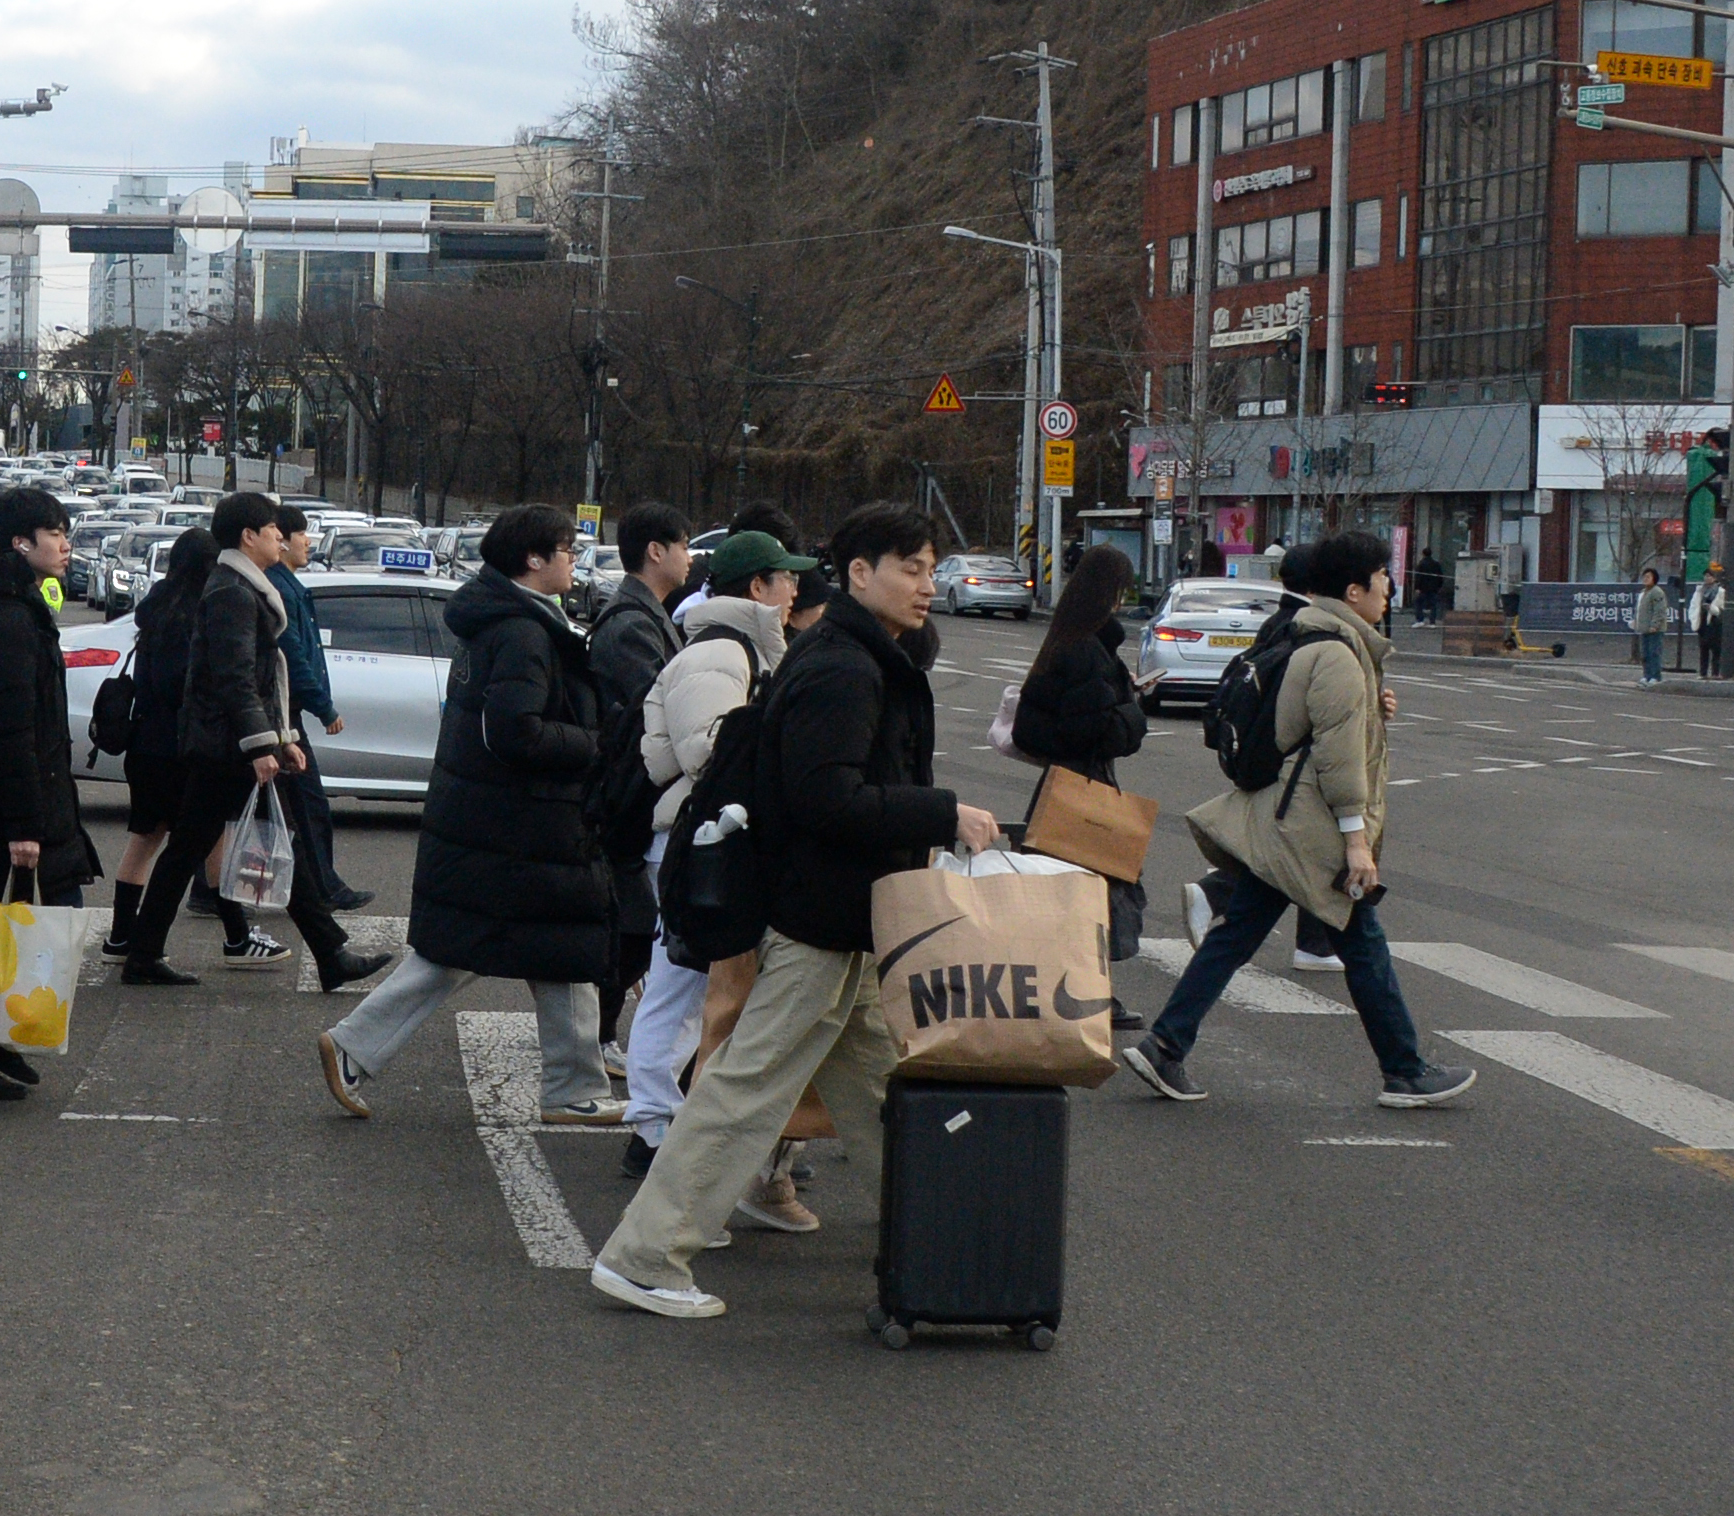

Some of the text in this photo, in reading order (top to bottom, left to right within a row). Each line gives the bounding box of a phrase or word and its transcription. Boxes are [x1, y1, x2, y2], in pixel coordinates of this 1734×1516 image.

[1607, 57, 1703, 83] 신호 과속 단속 장비
[1048, 410, 1069, 430] 60
[385, 552, 427, 566] 전주사랑
[1573, 591, 1606, 605] 제주항공
[1571, 606, 1618, 622] 희생자의
[908, 963, 1041, 1030] NIKE
